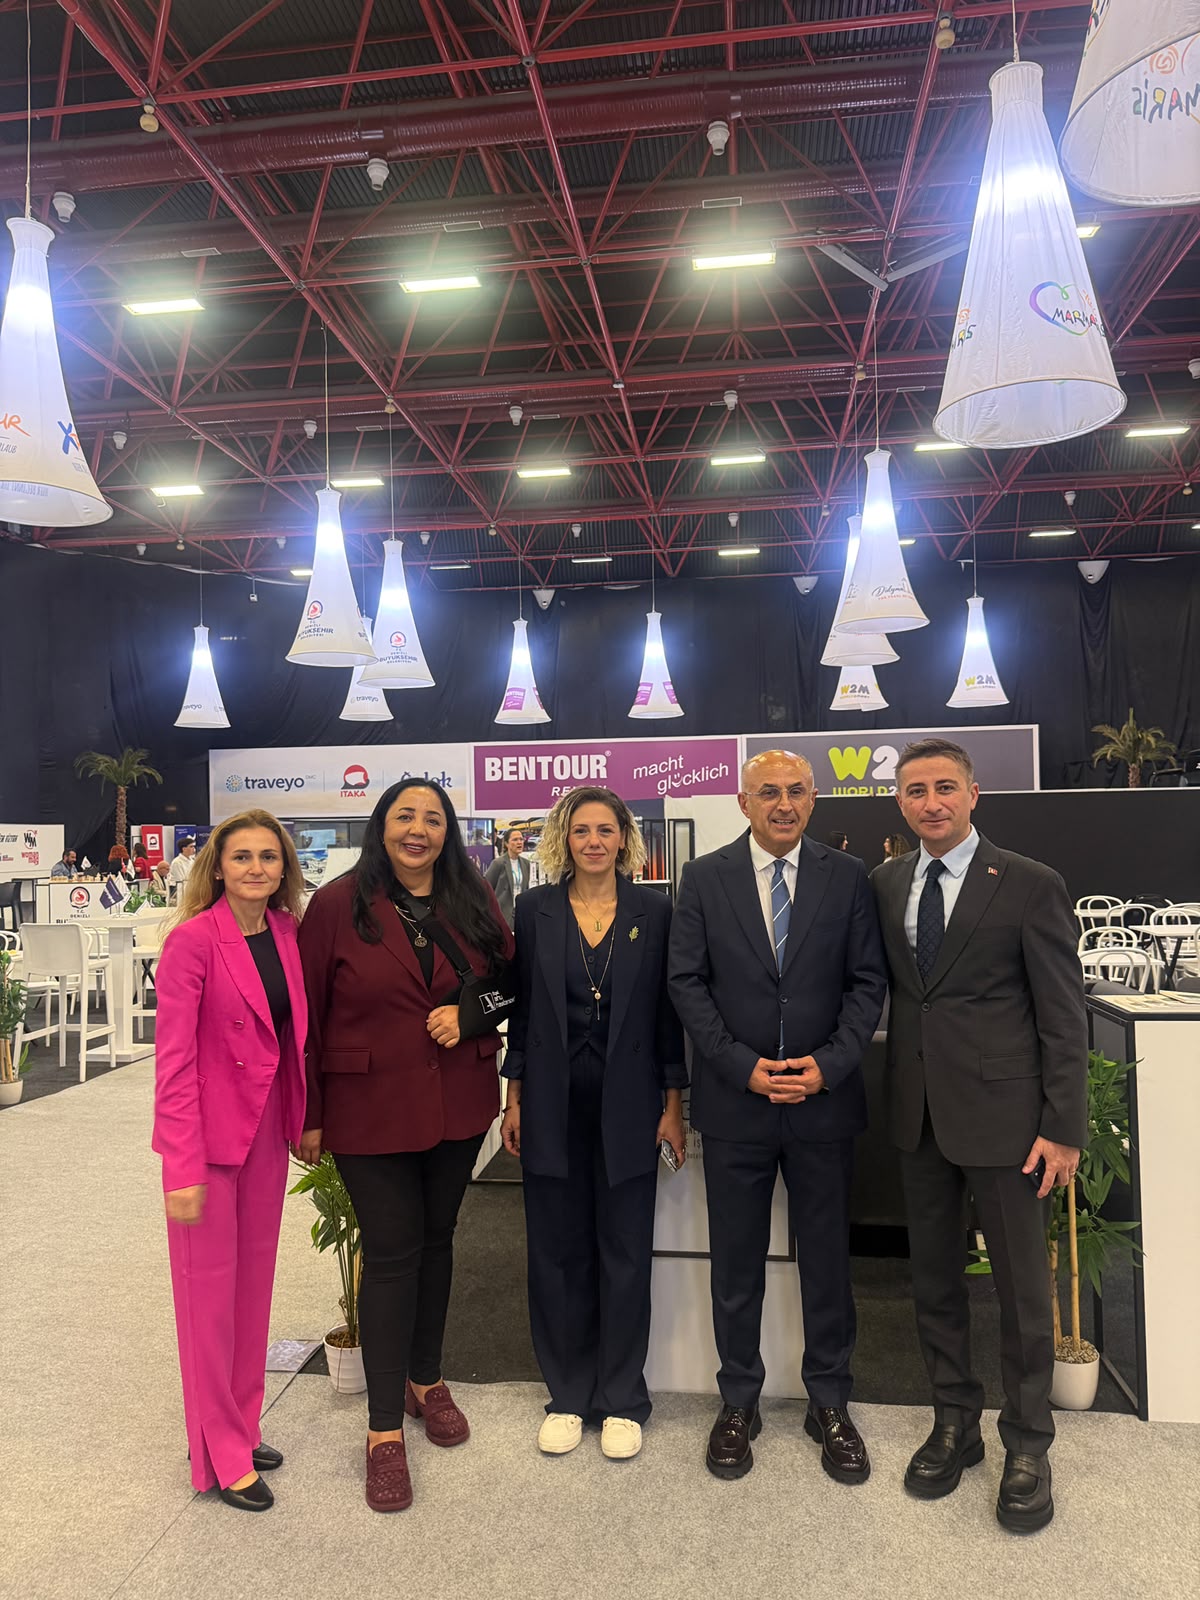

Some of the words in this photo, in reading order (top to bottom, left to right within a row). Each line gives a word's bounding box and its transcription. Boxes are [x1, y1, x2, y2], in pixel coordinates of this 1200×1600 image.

[964, 674, 996, 687] W2M
[840, 684, 870, 695] W2M
[633, 754, 684, 780] macht
[827, 745, 899, 781] W2
[244, 776, 305, 792] traveyo
[340, 790, 367, 798] ITAKA
